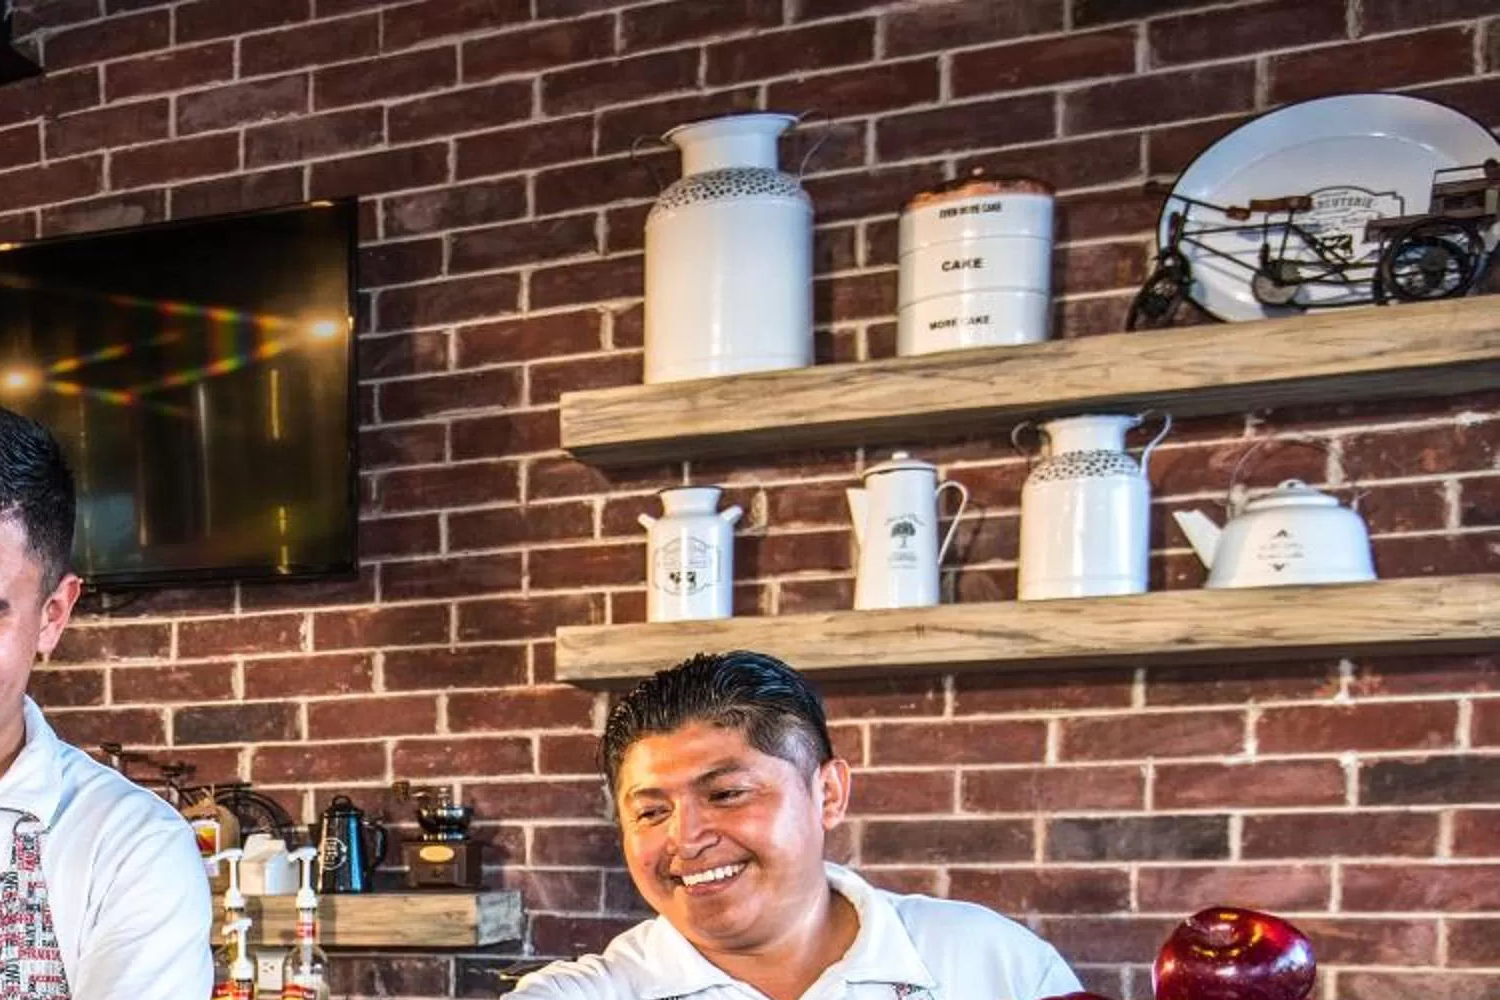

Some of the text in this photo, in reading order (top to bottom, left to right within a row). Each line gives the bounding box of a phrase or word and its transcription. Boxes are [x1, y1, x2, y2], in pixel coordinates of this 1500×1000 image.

[941, 258, 983, 272] CAKE
[929, 315, 990, 331] MORE AKE
